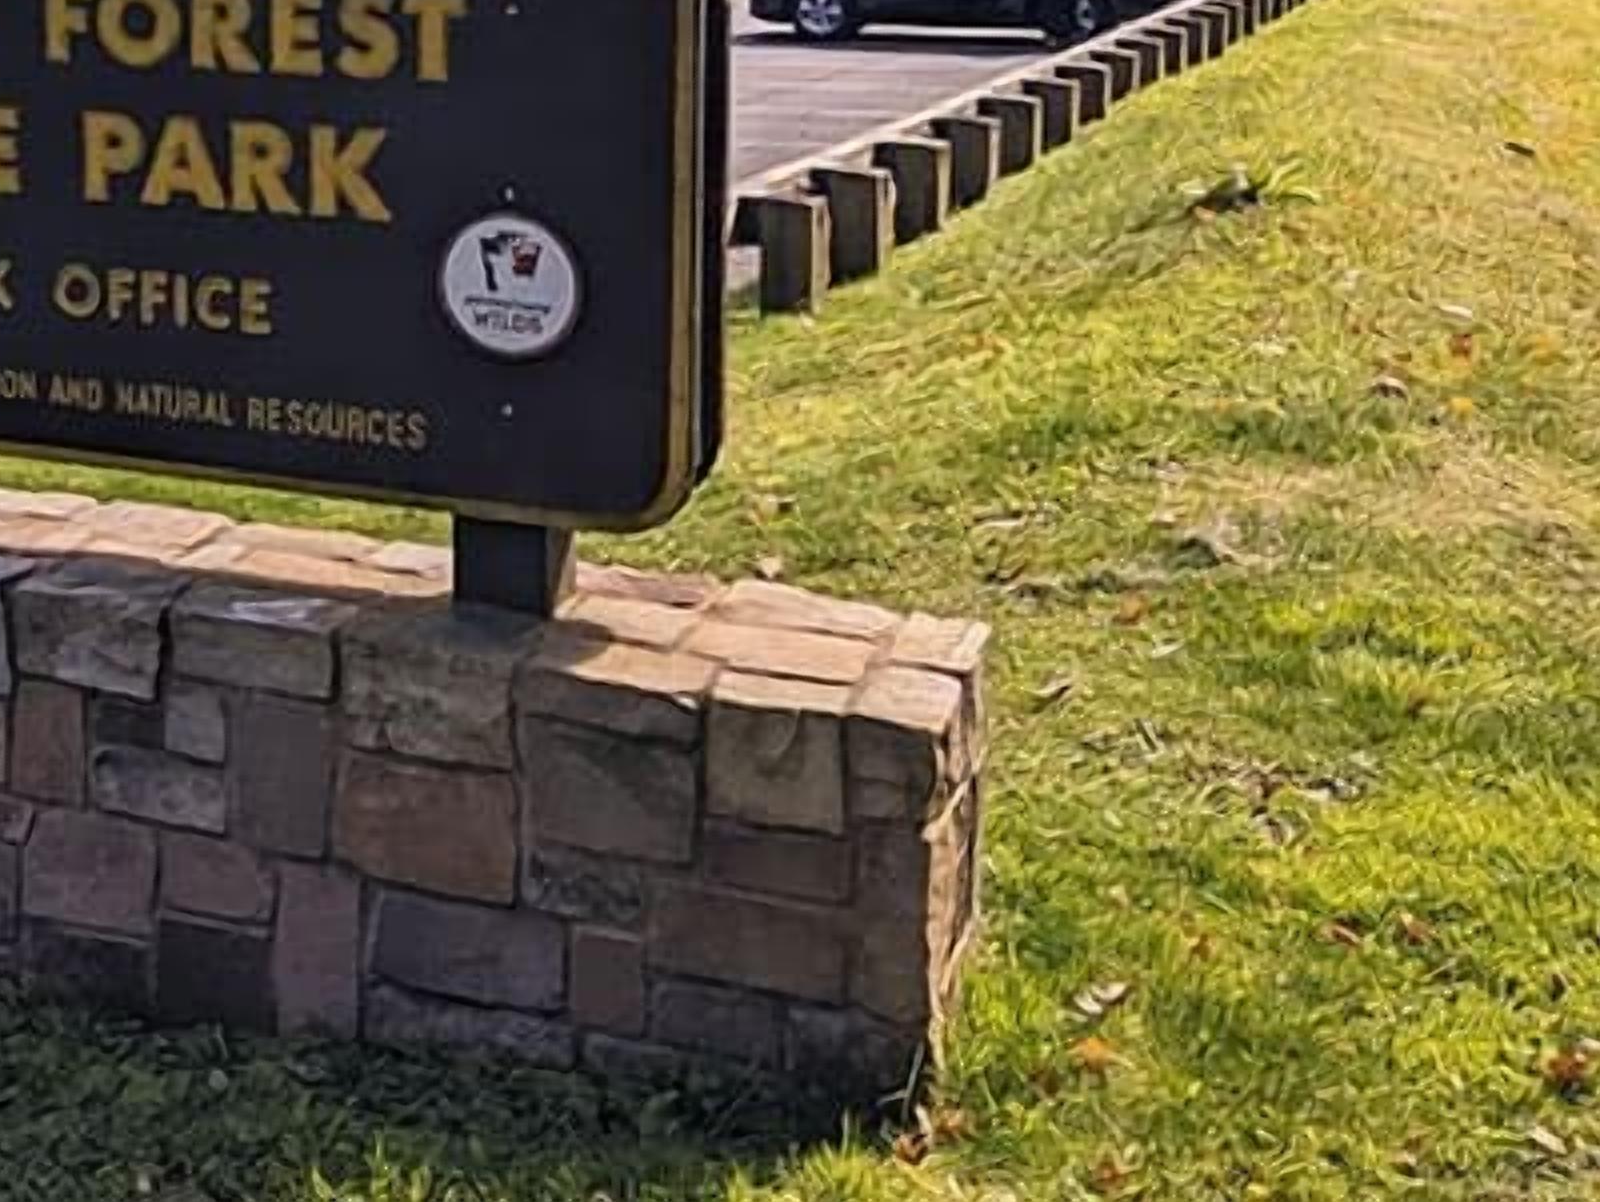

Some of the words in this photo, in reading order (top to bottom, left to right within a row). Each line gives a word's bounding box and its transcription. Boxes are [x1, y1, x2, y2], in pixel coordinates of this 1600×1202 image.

[83, 110, 392, 223] PARK
[53, 264, 273, 335] OFFICE
[49, 375, 102, 410] AND
[115, 380, 232, 427] NATURAL
[247, 397, 427, 449] RESOURCES
